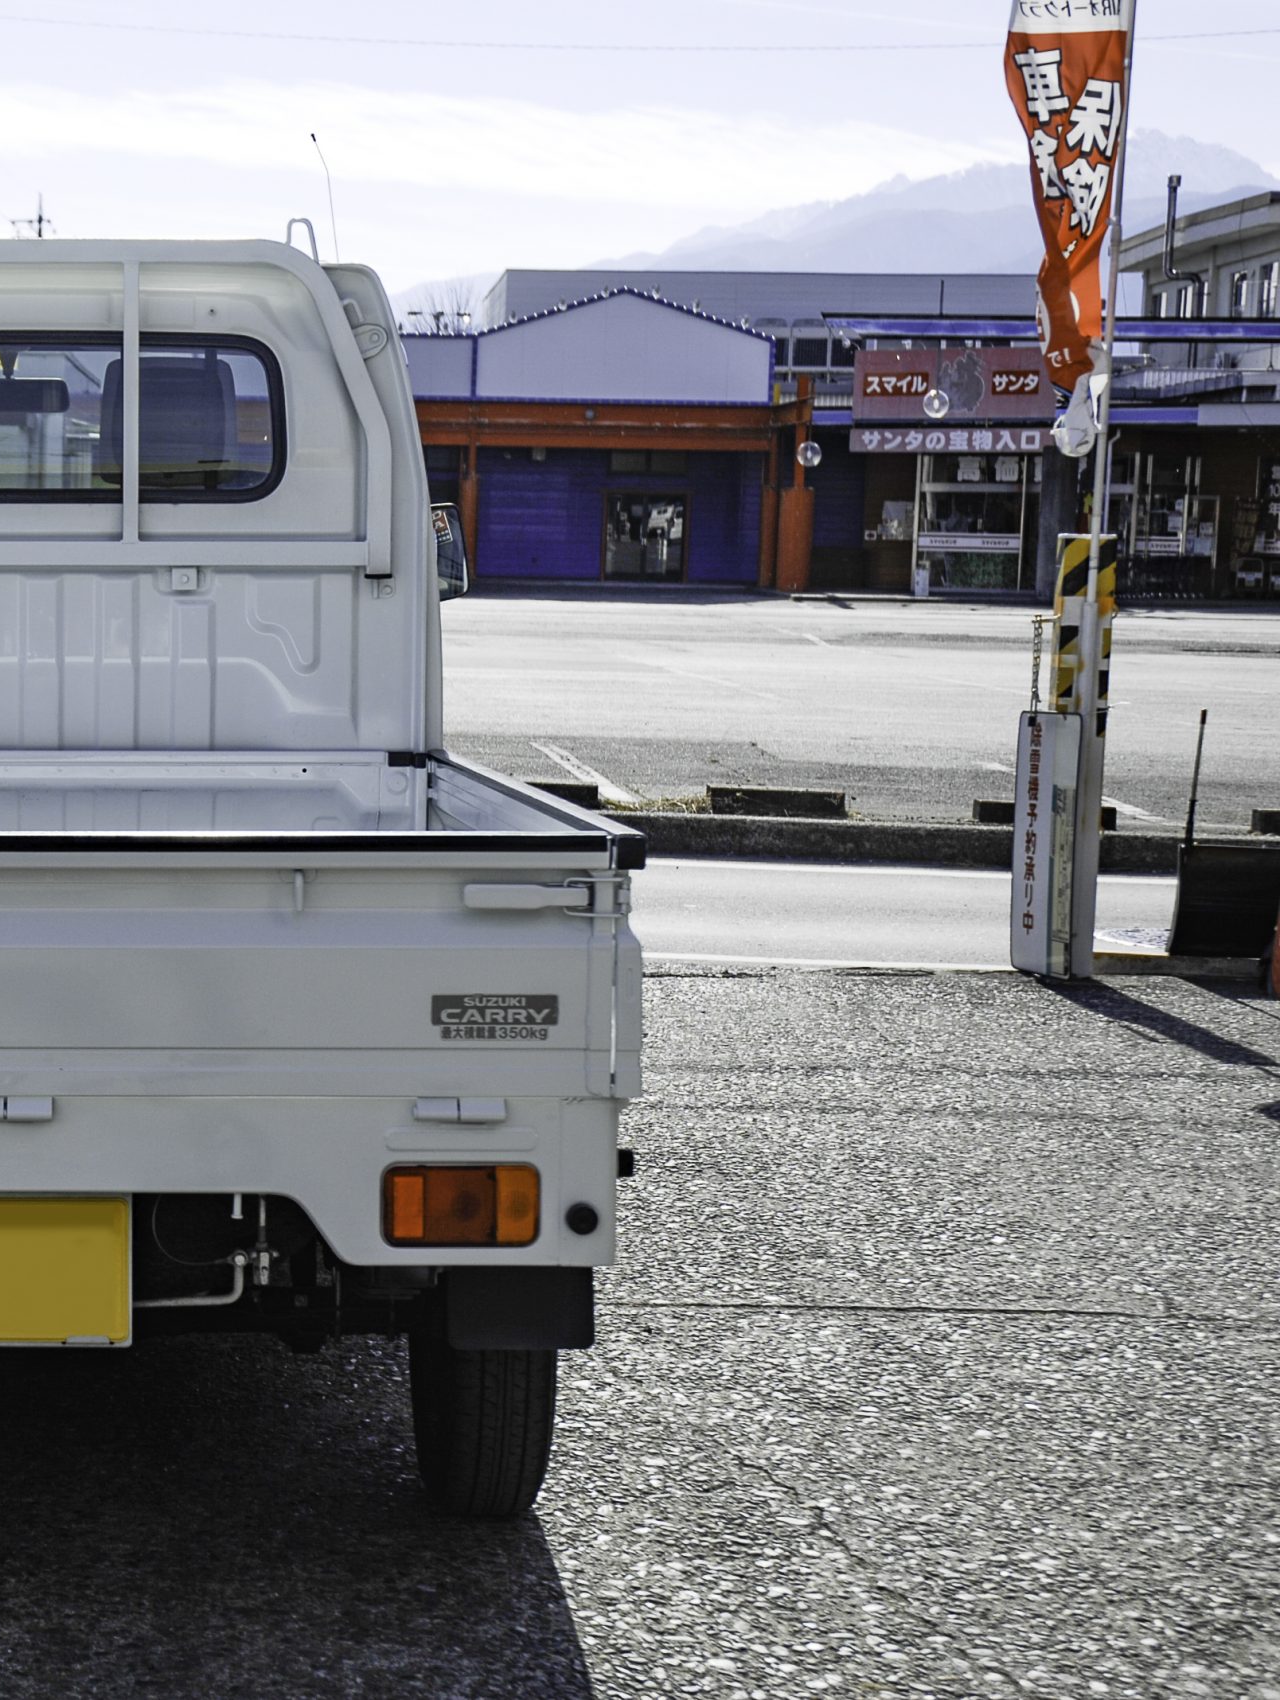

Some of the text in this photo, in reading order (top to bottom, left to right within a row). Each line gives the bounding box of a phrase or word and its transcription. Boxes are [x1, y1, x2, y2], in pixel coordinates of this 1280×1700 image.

[865, 375, 928, 395] スマイル
[992, 373, 1040, 393] サンタ
[861, 429, 1042, 452] サンタの宝物入口
[463, 996, 527, 1007] SUZUKI
[440, 1008, 551, 1023] CARRY
[441, 1026, 549, 1041] 最大積載量350kg
